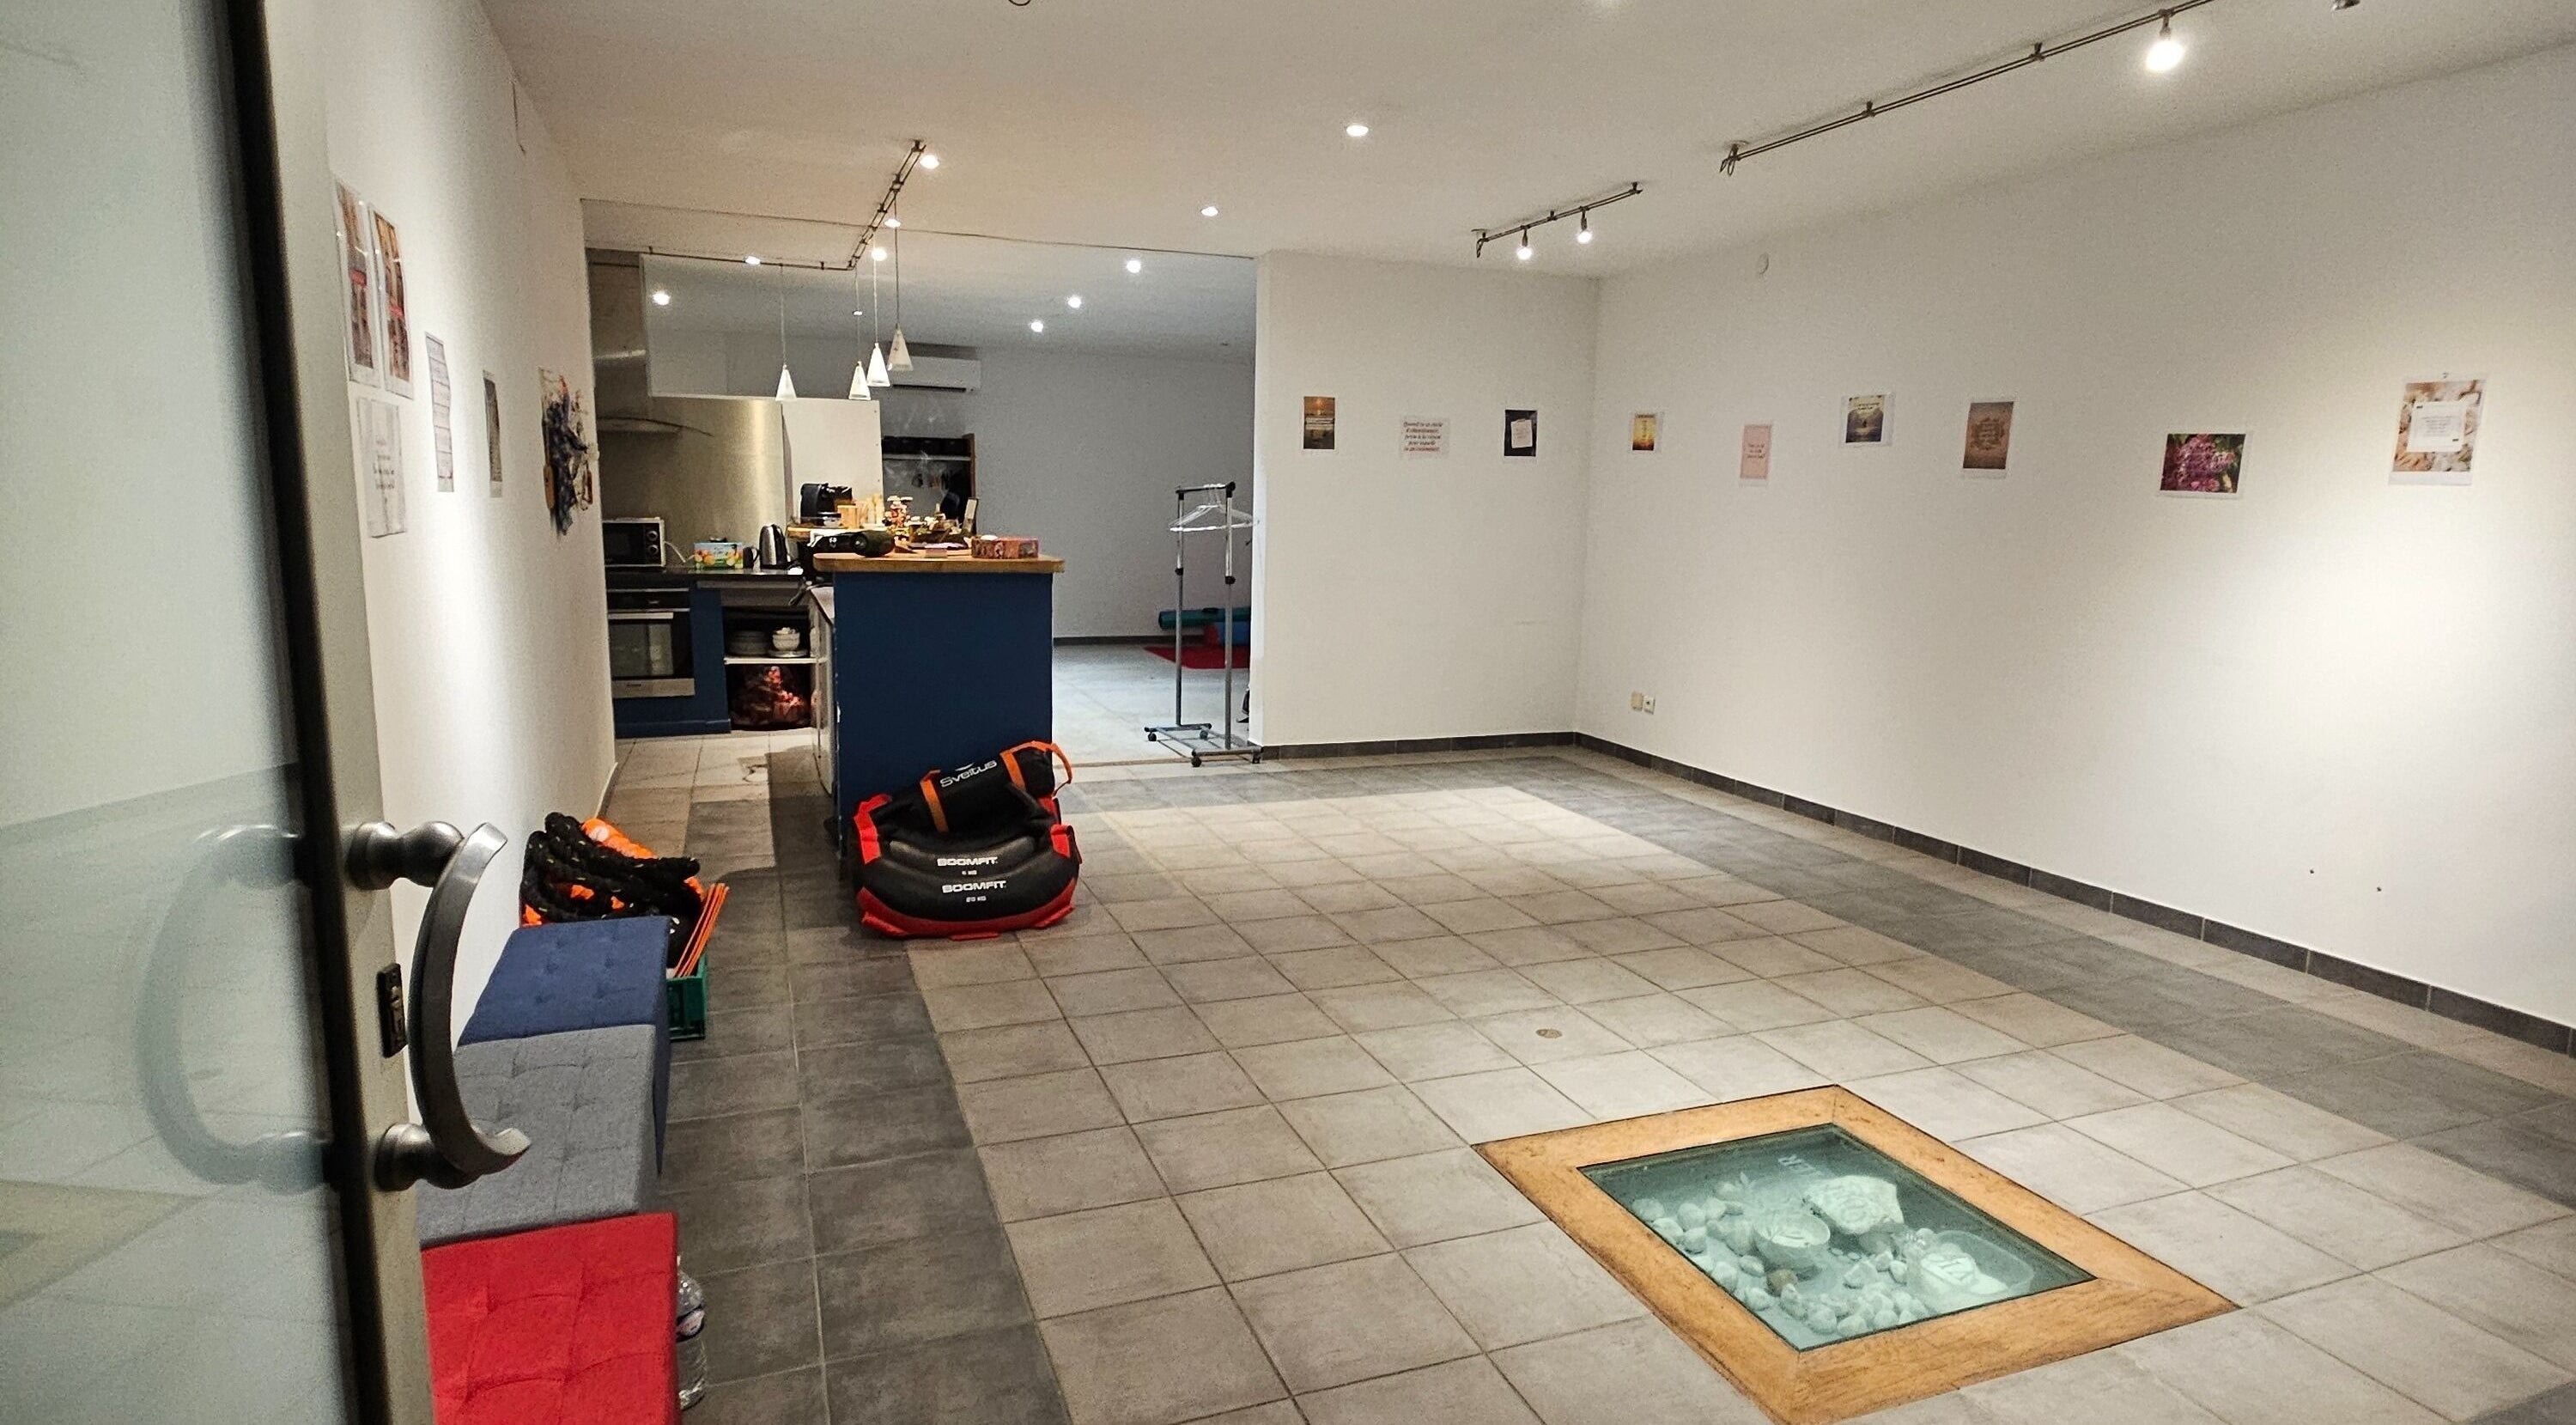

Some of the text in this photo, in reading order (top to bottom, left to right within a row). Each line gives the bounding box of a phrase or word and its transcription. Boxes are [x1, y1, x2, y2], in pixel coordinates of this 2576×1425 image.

[939, 760, 998, 788] Sveltus
[937, 856, 998, 867] BOOMFIT
[942, 880, 1007, 893] BOOMFIT
